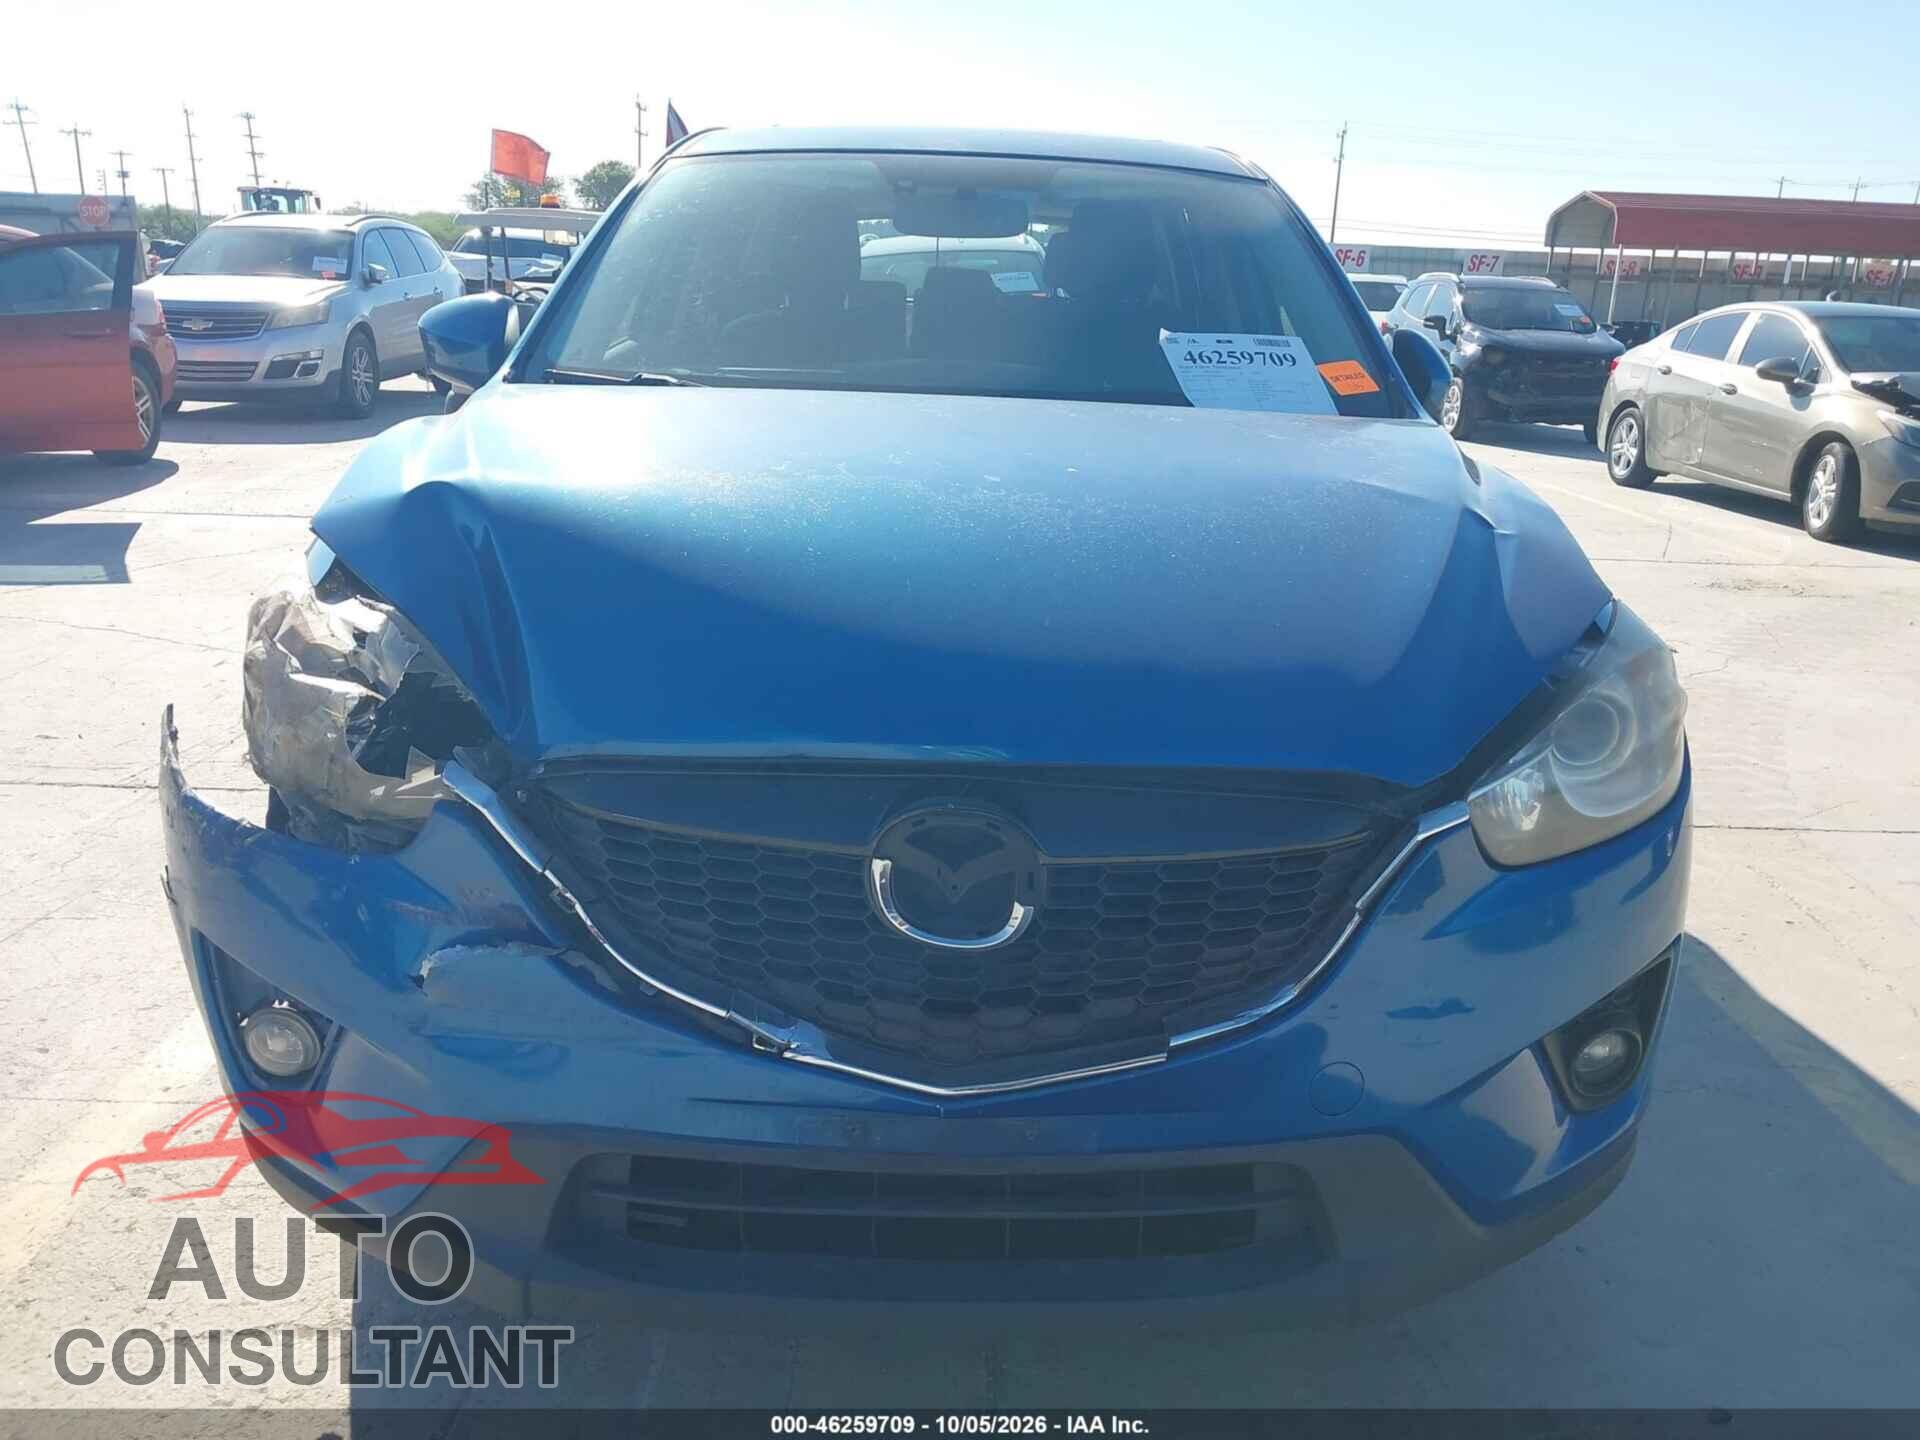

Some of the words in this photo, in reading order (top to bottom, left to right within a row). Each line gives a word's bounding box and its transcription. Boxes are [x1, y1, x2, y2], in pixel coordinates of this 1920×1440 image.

[1335, 249, 1366, 268] SF-6
[1467, 254, 1500, 273] SF-7
[1183, 350, 1297, 367] 46259709
